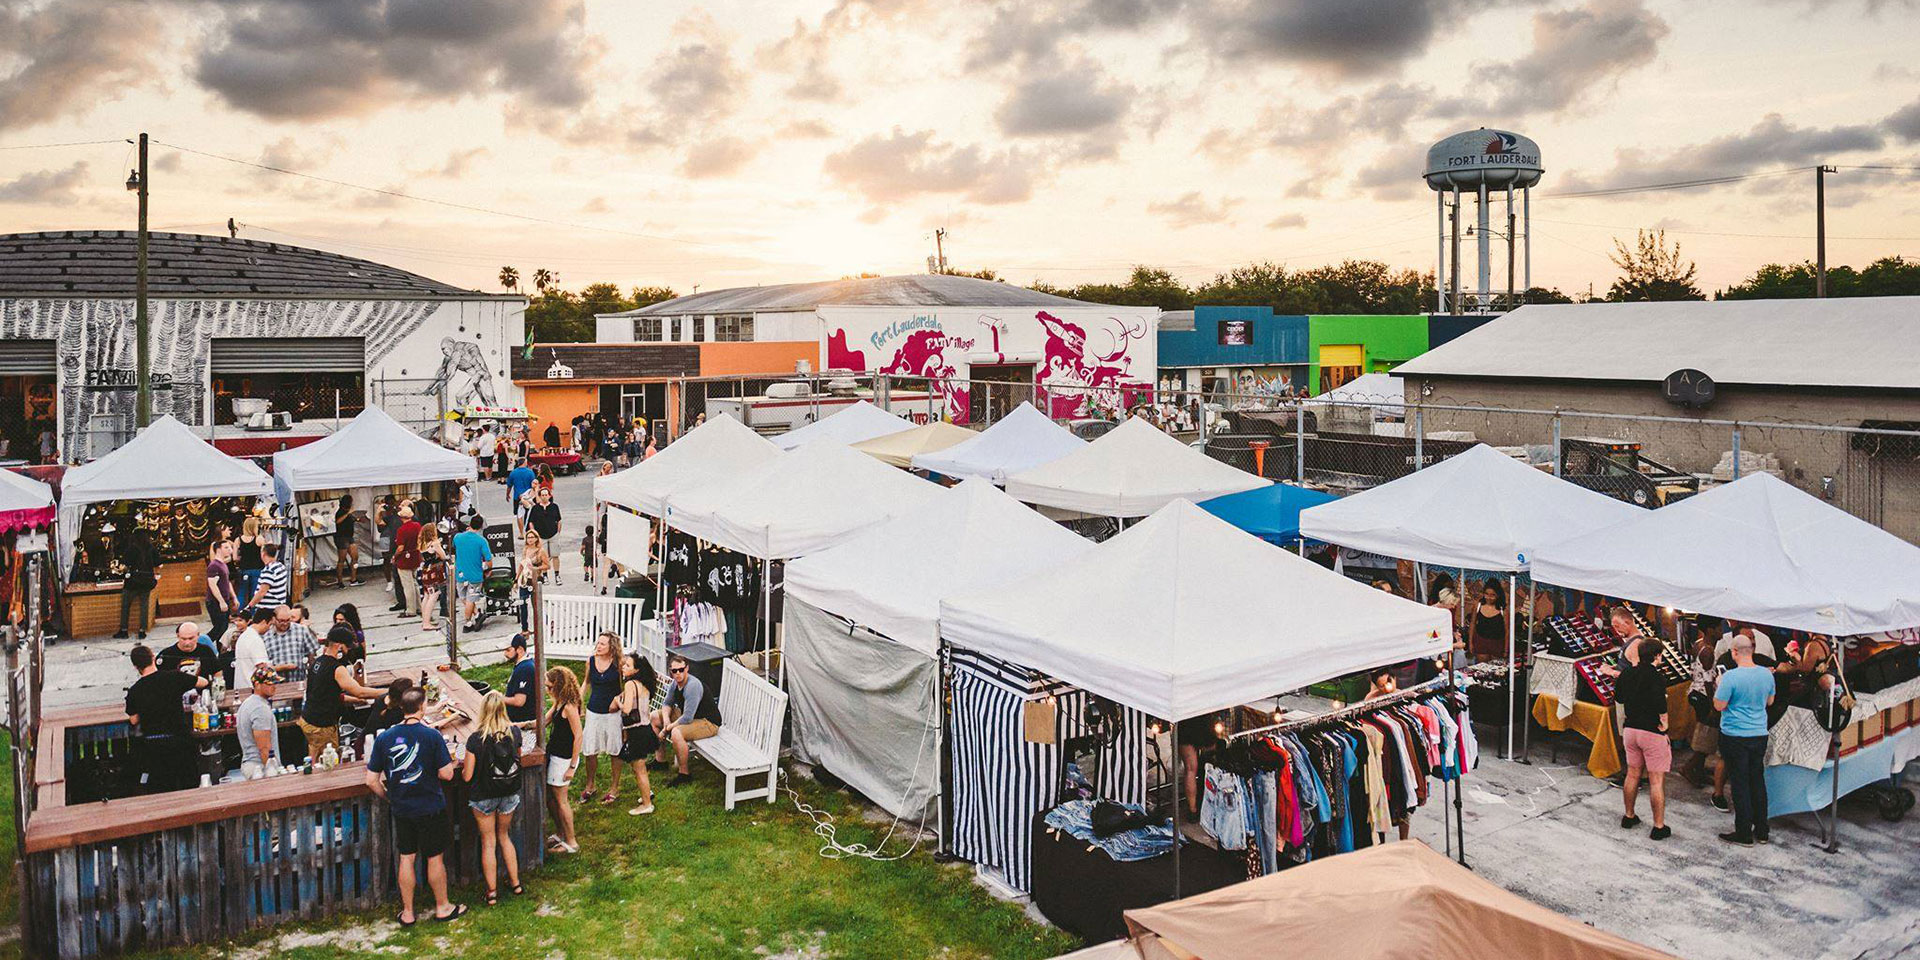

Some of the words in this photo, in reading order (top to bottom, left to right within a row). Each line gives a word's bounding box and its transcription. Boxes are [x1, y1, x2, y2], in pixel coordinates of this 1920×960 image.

[1448, 155, 1475, 167] FORT
[1480, 154, 1537, 165] LAUDERDALE
[871, 325, 893, 351] Fort
[892, 314, 942, 337] Lauderdale
[487, 532, 509, 540] GOOSE
